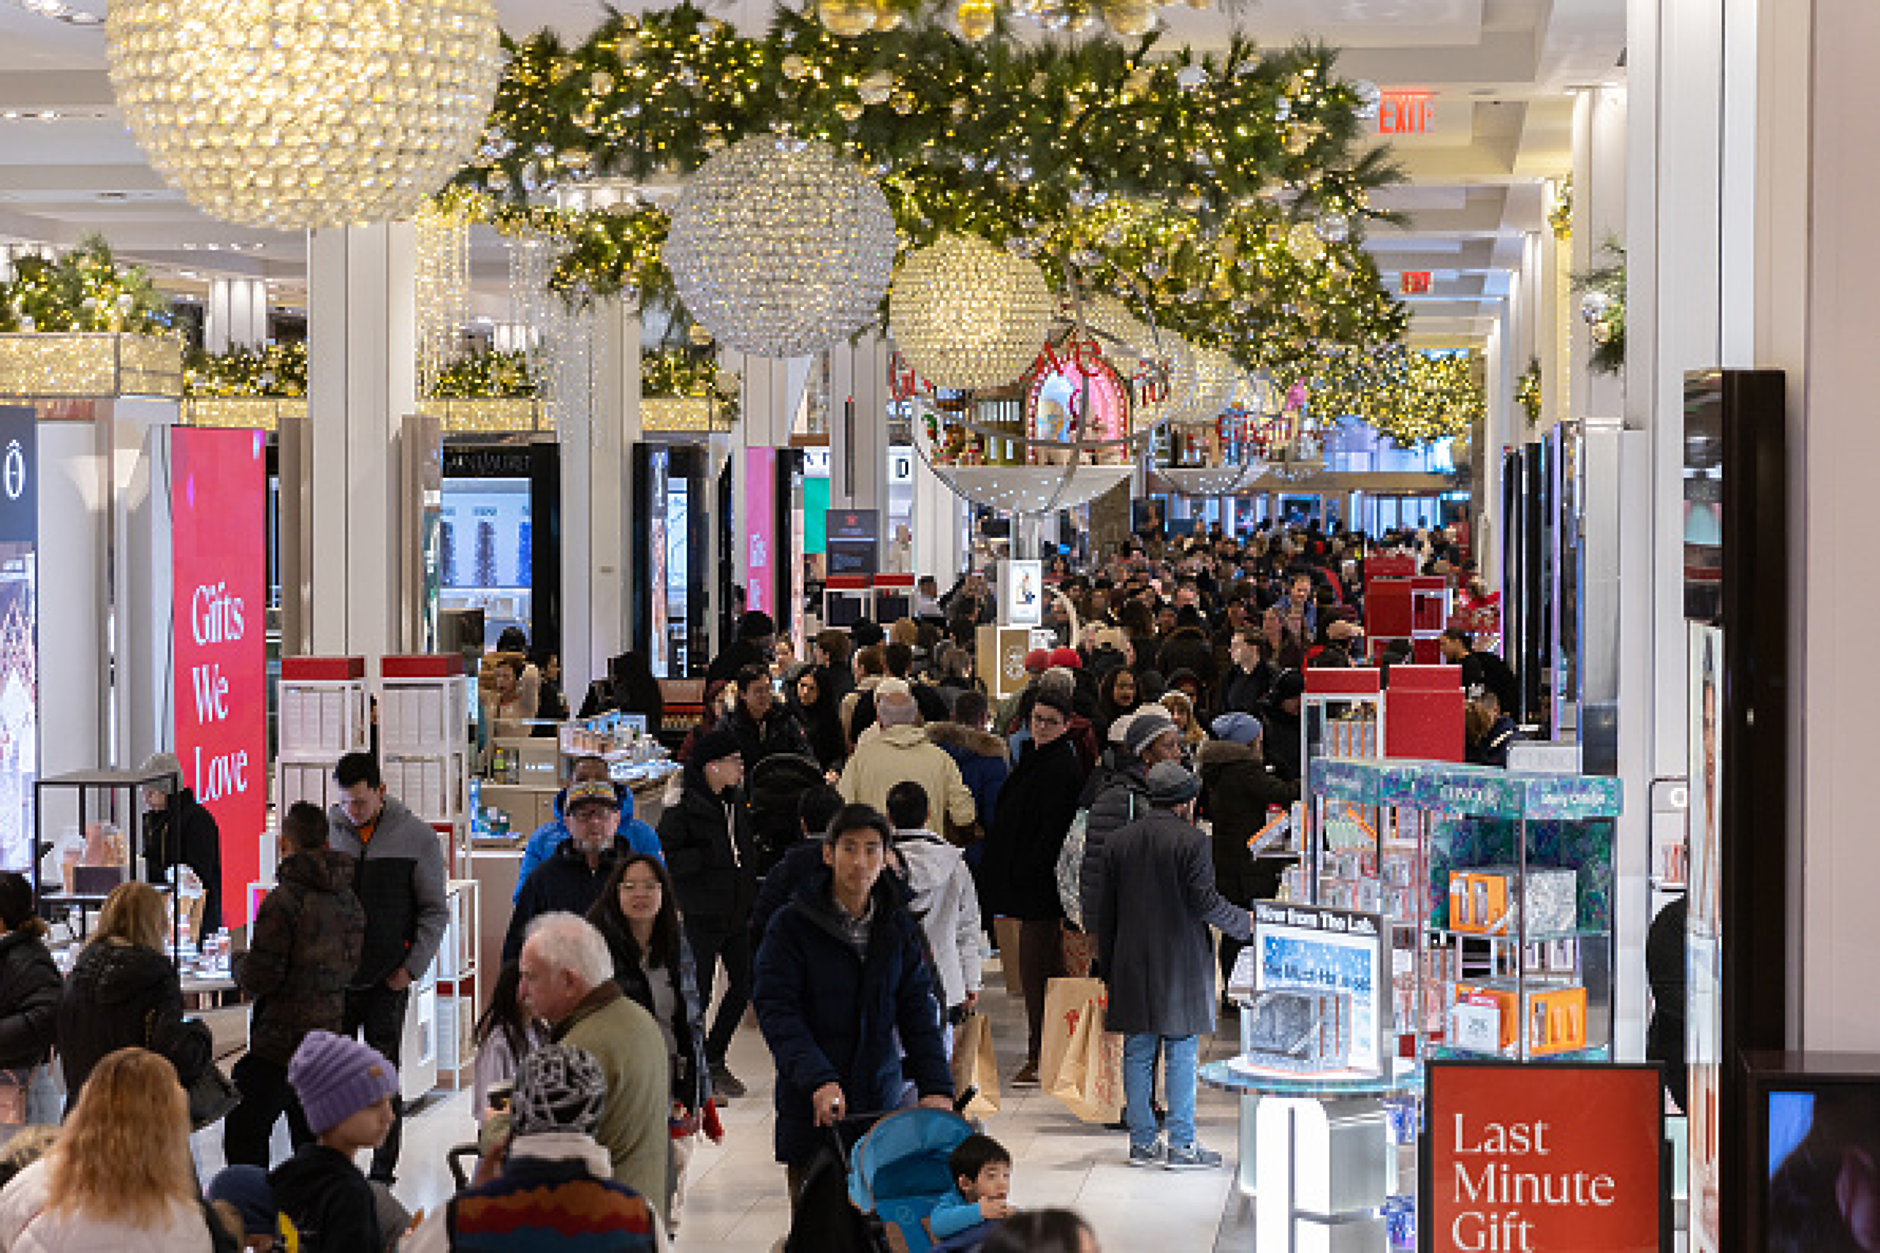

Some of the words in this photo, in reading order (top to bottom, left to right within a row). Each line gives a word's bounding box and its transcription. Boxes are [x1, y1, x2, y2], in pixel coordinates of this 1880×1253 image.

[1379, 96, 1427, 134] EXIT
[191, 581, 245, 646] Gifts
[192, 663, 229, 725] We
[194, 747, 248, 805] Love
[1453, 1112, 1551, 1155] Last
[1453, 1161, 1616, 1206] Minute
[1452, 1208, 1535, 1253] Gift
